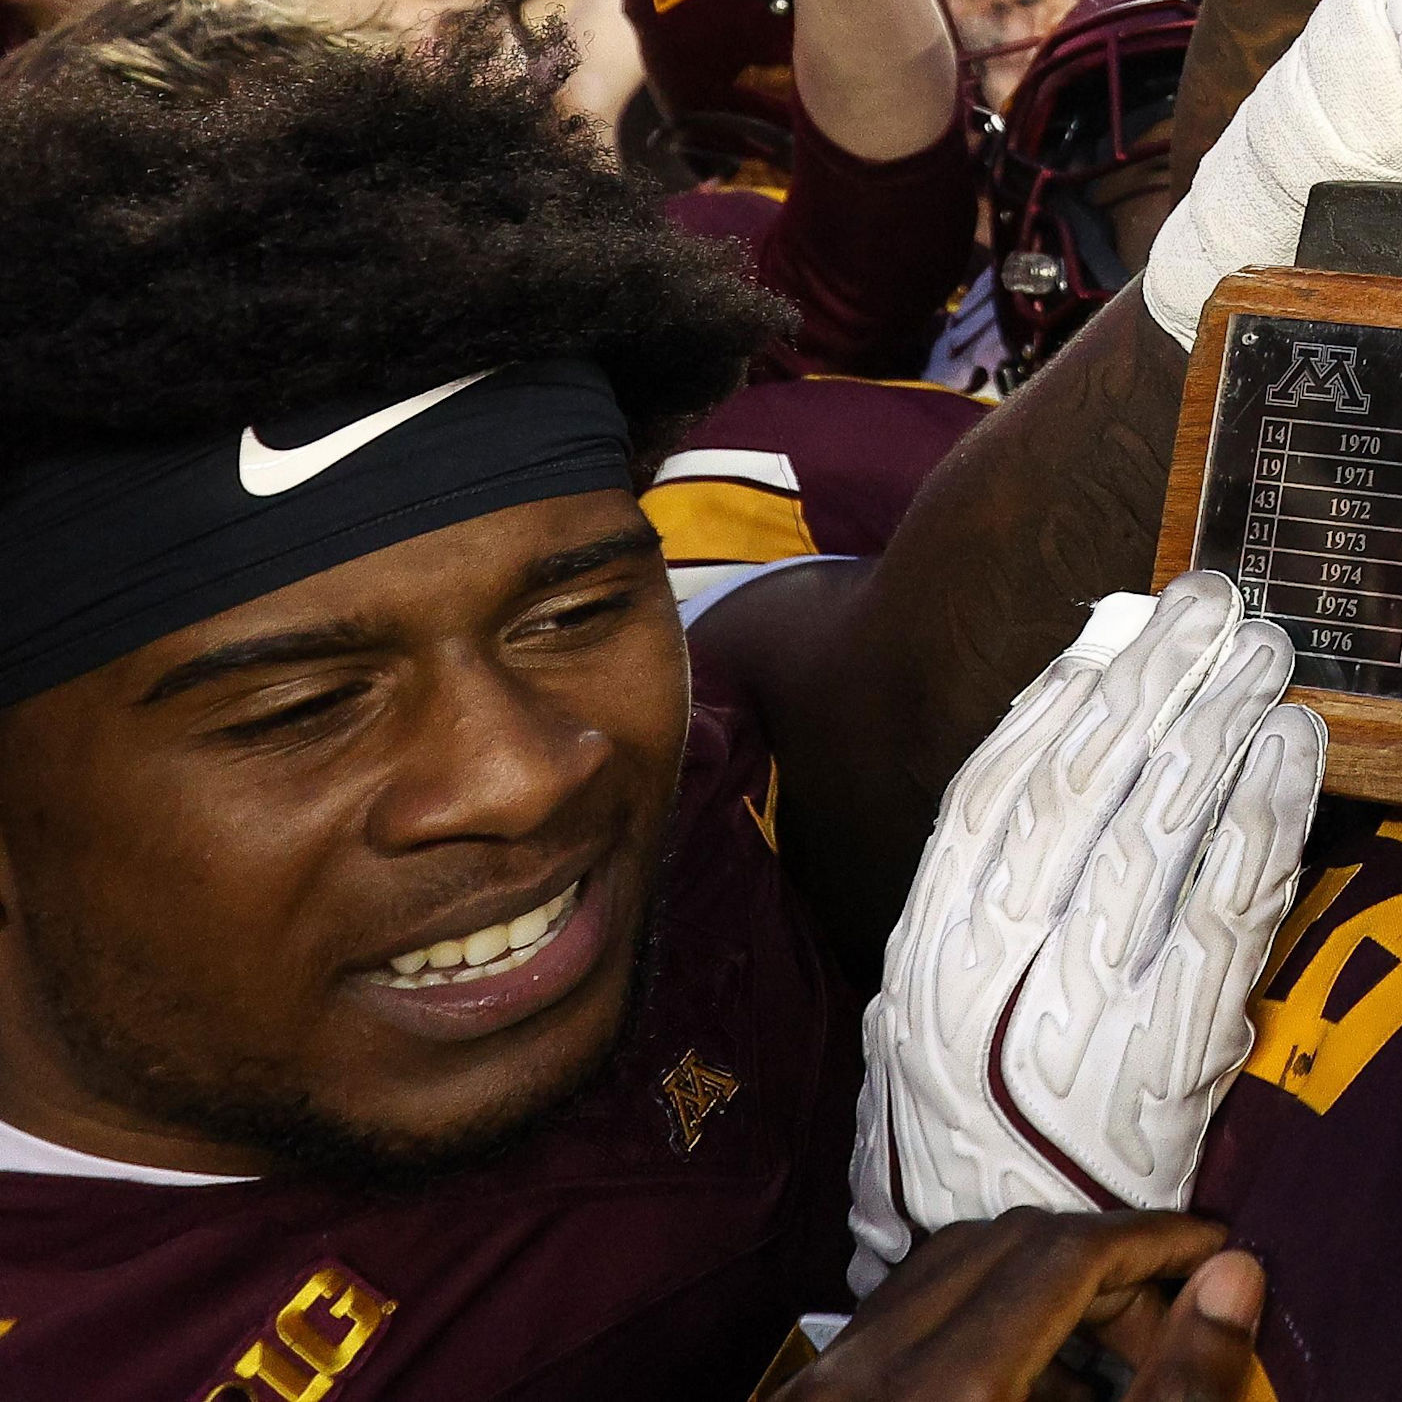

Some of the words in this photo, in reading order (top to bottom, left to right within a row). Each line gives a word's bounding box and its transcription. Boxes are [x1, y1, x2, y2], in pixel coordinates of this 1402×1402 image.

[1265, 341, 1372, 415] M
[1265, 425, 1286, 445] 14
[1338, 433, 1382, 455] 1970
[1260, 457, 1282, 477] 19
[1334, 465, 1375, 488] 1971
[1254, 489, 1276, 510] 43
[1329, 497, 1372, 520] 1972
[1248, 521, 1270, 542] 31
[1325, 529, 1368, 552] 1973
[1244, 554, 1266, 574] 23
[1320, 562, 1363, 585] 1974
[1241, 586, 1260, 607] 31
[1315, 594, 1359, 619] 1975
[1309, 628, 1354, 652] 1976
